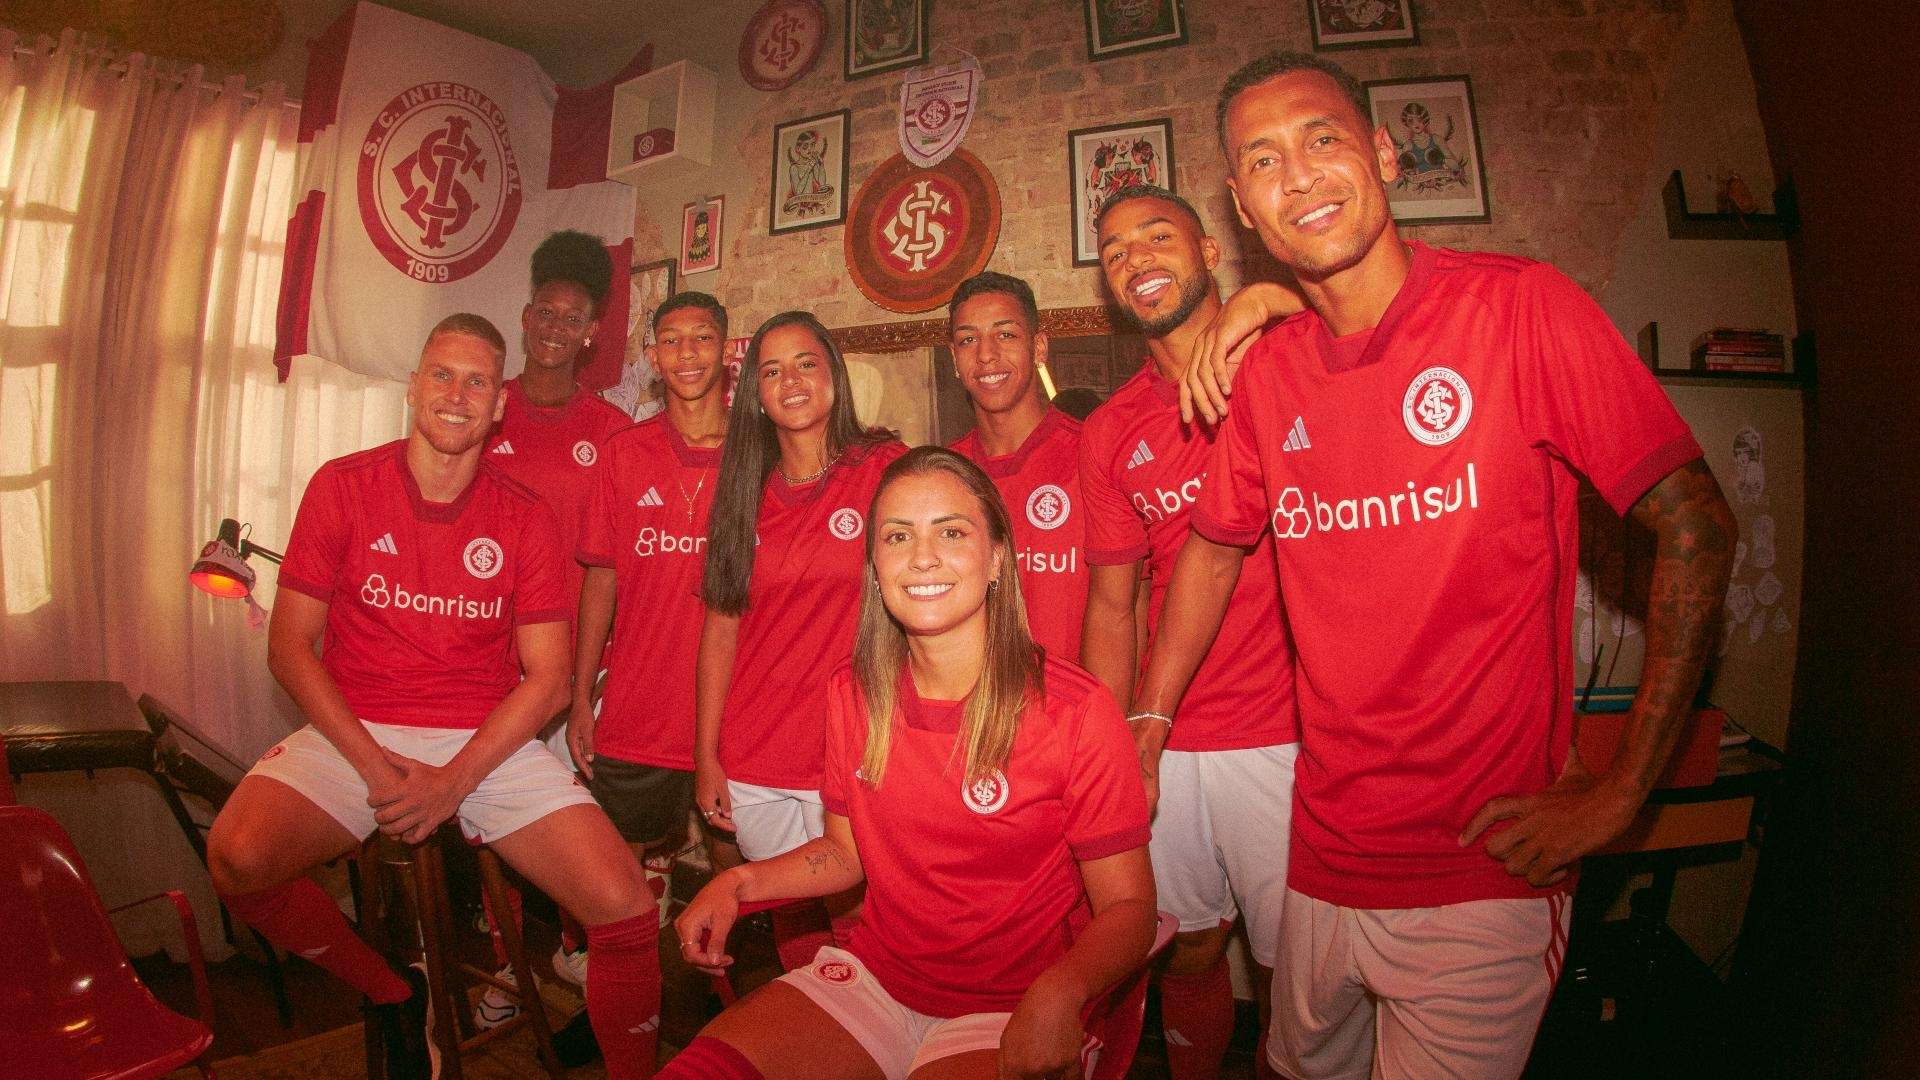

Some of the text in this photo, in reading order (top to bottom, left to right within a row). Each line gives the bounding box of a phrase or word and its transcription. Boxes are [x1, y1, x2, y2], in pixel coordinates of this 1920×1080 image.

[407, 259, 449, 281] 1909
[1313, 462, 1478, 532] banrisul
[394, 583, 503, 620] banrisul
